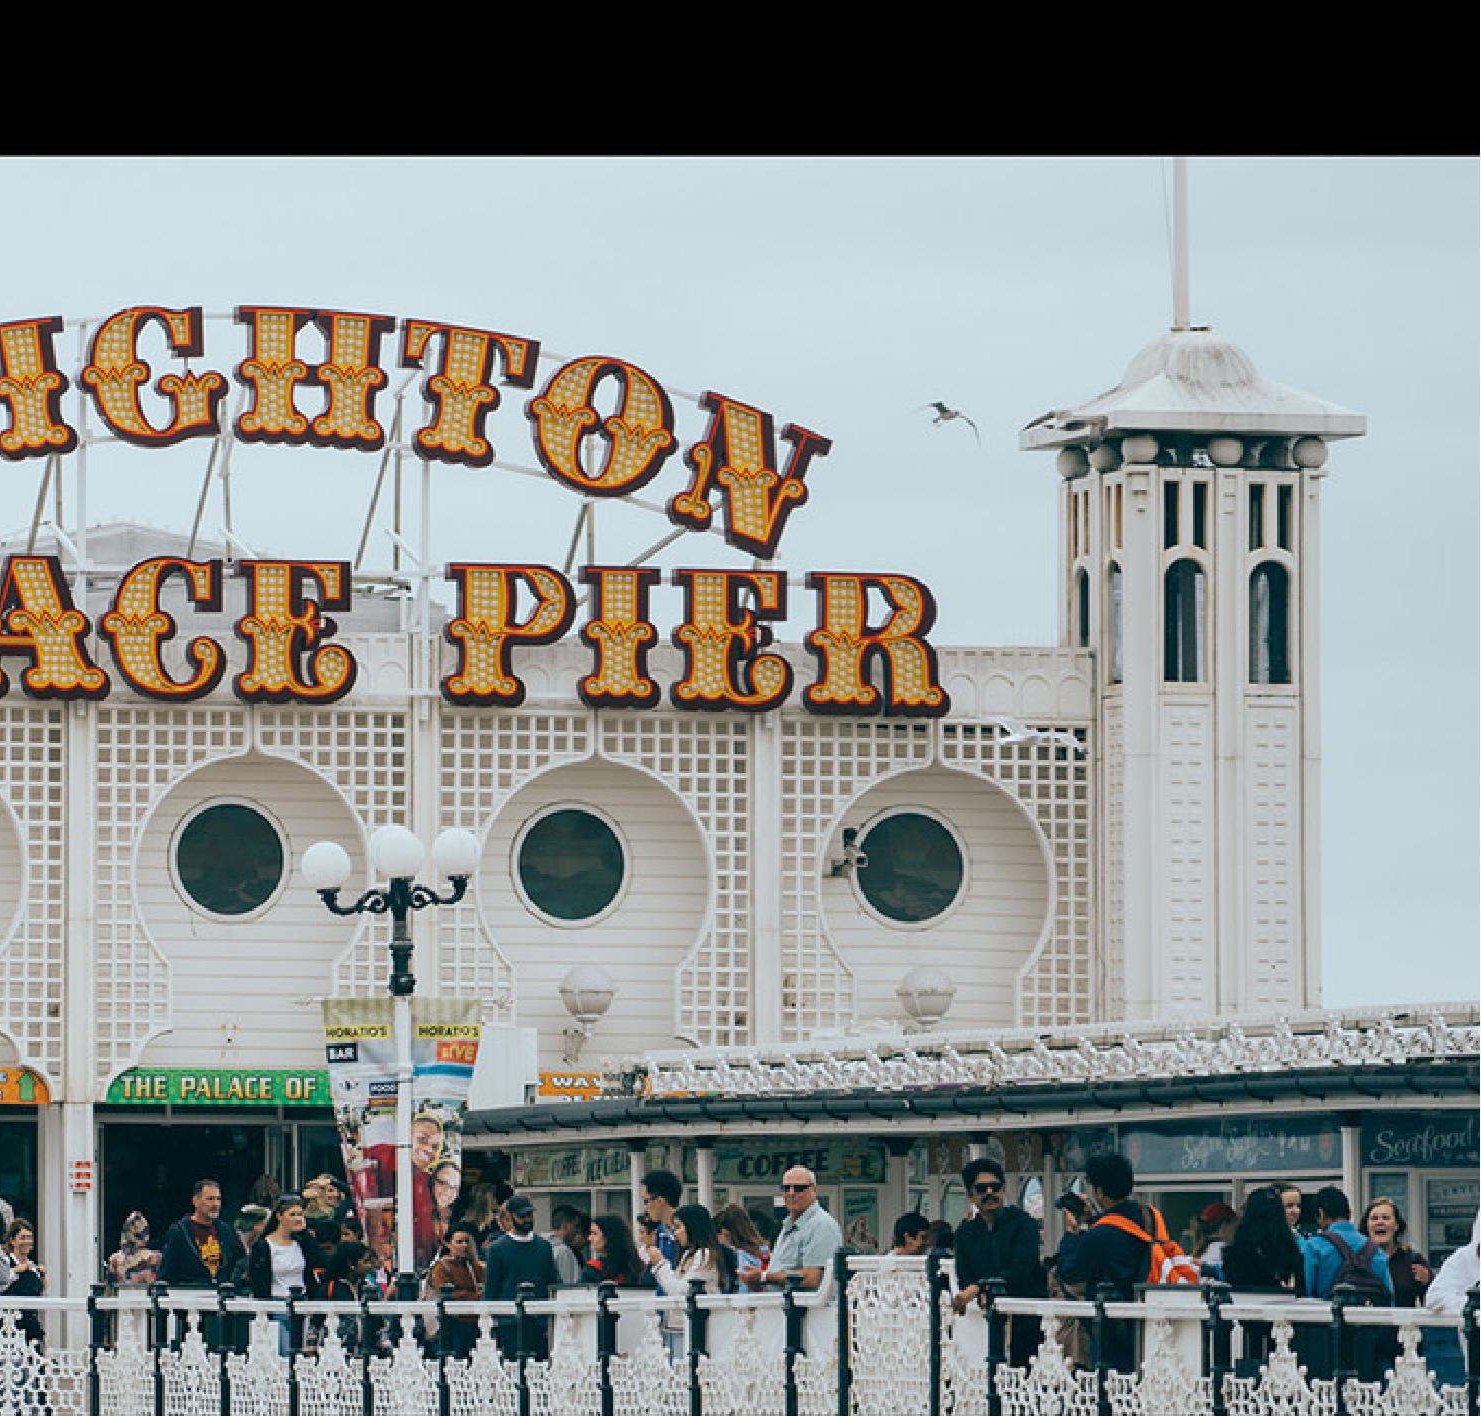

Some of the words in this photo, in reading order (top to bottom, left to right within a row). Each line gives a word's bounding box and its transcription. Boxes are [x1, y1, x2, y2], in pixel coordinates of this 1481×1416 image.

[441, 562, 951, 718] PIER
[329, 1047, 355, 1060] BAR
[442, 1043, 474, 1060] LIVE
[121, 1075, 168, 1099] THE
[180, 1075, 272, 1099] PALACE
[285, 1075, 316, 1099] OF
[1370, 1117, 1474, 1163] Seafood
[739, 1149, 830, 1178] COFFEE
